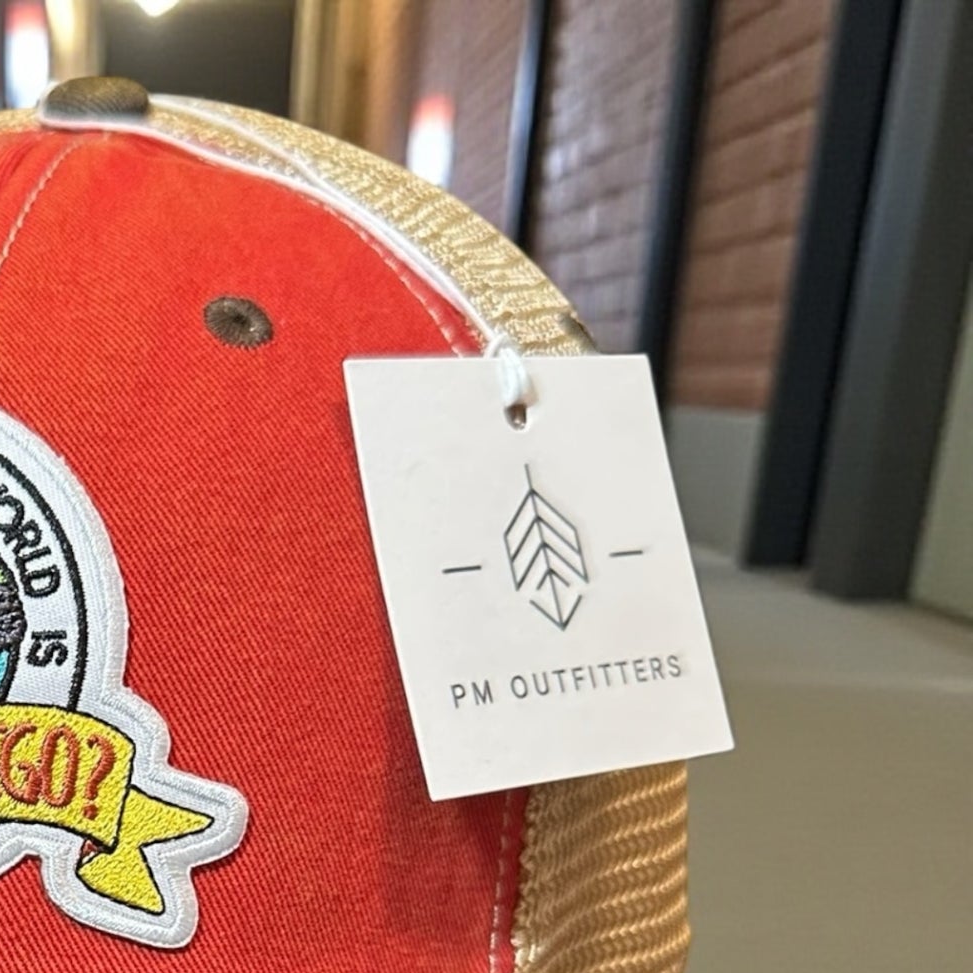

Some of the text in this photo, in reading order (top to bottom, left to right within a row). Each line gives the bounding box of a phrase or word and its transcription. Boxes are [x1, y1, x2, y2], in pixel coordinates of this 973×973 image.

[27, 628, 69, 669] IS
[450, 655, 683, 709] PM OUTFITTERS
